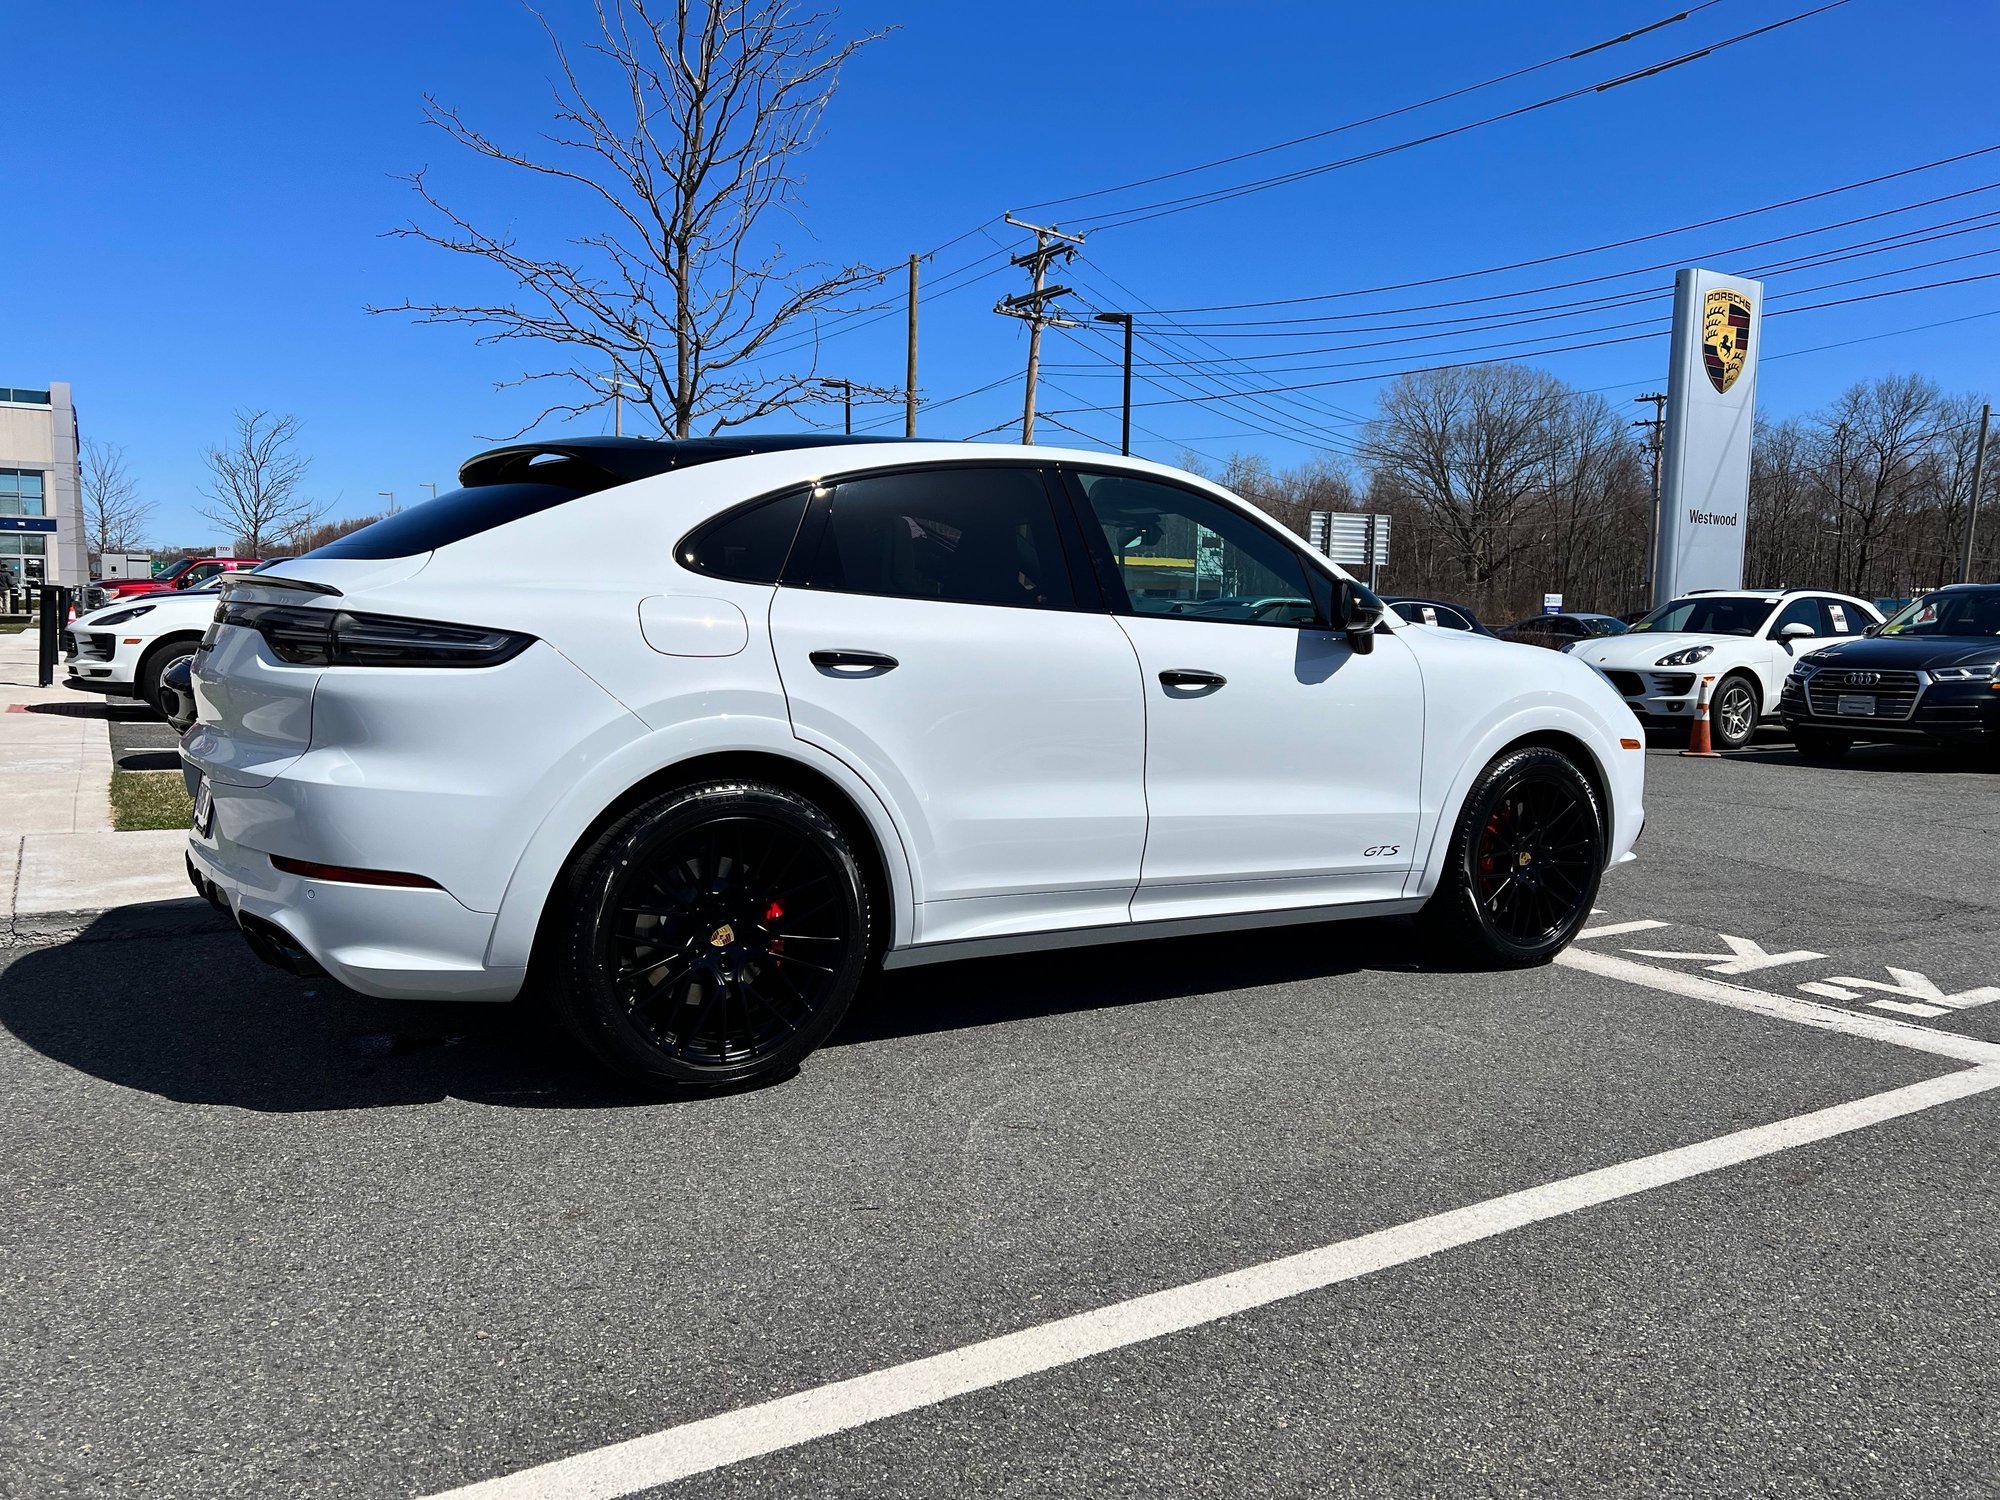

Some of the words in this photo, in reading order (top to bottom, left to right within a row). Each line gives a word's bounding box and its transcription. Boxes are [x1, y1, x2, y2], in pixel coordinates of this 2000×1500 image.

[1707, 292, 1751, 311] PORSCHE
[1689, 509, 1737, 526] Westwood
[1363, 845, 1401, 857] GTS
